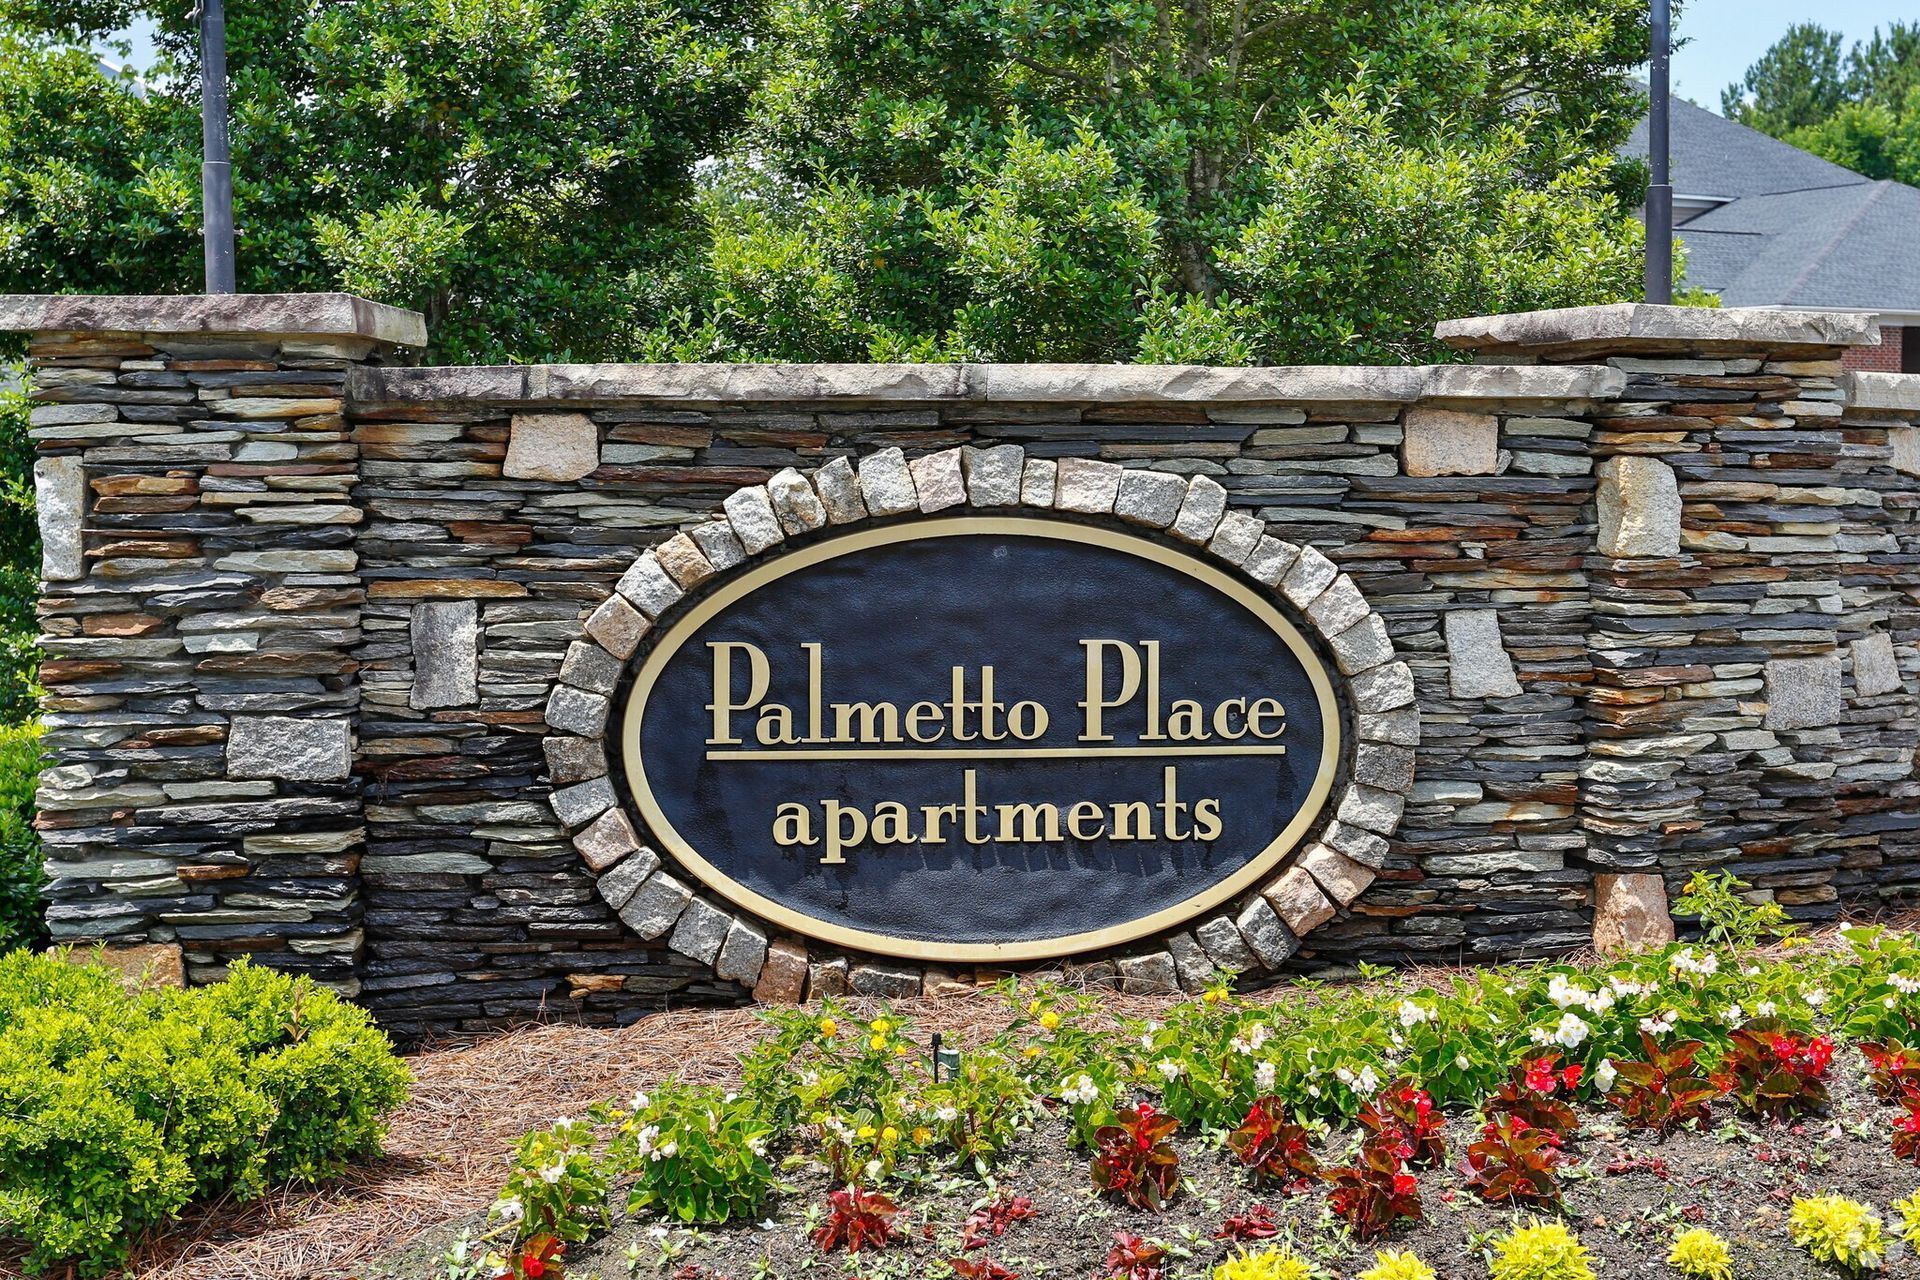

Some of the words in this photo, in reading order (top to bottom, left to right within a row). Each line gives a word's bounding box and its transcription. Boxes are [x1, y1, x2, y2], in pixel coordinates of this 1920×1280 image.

[705, 640, 1049, 745] Palmetto
[1077, 639, 1287, 742] Place
[772, 766, 1223, 865] apartments
